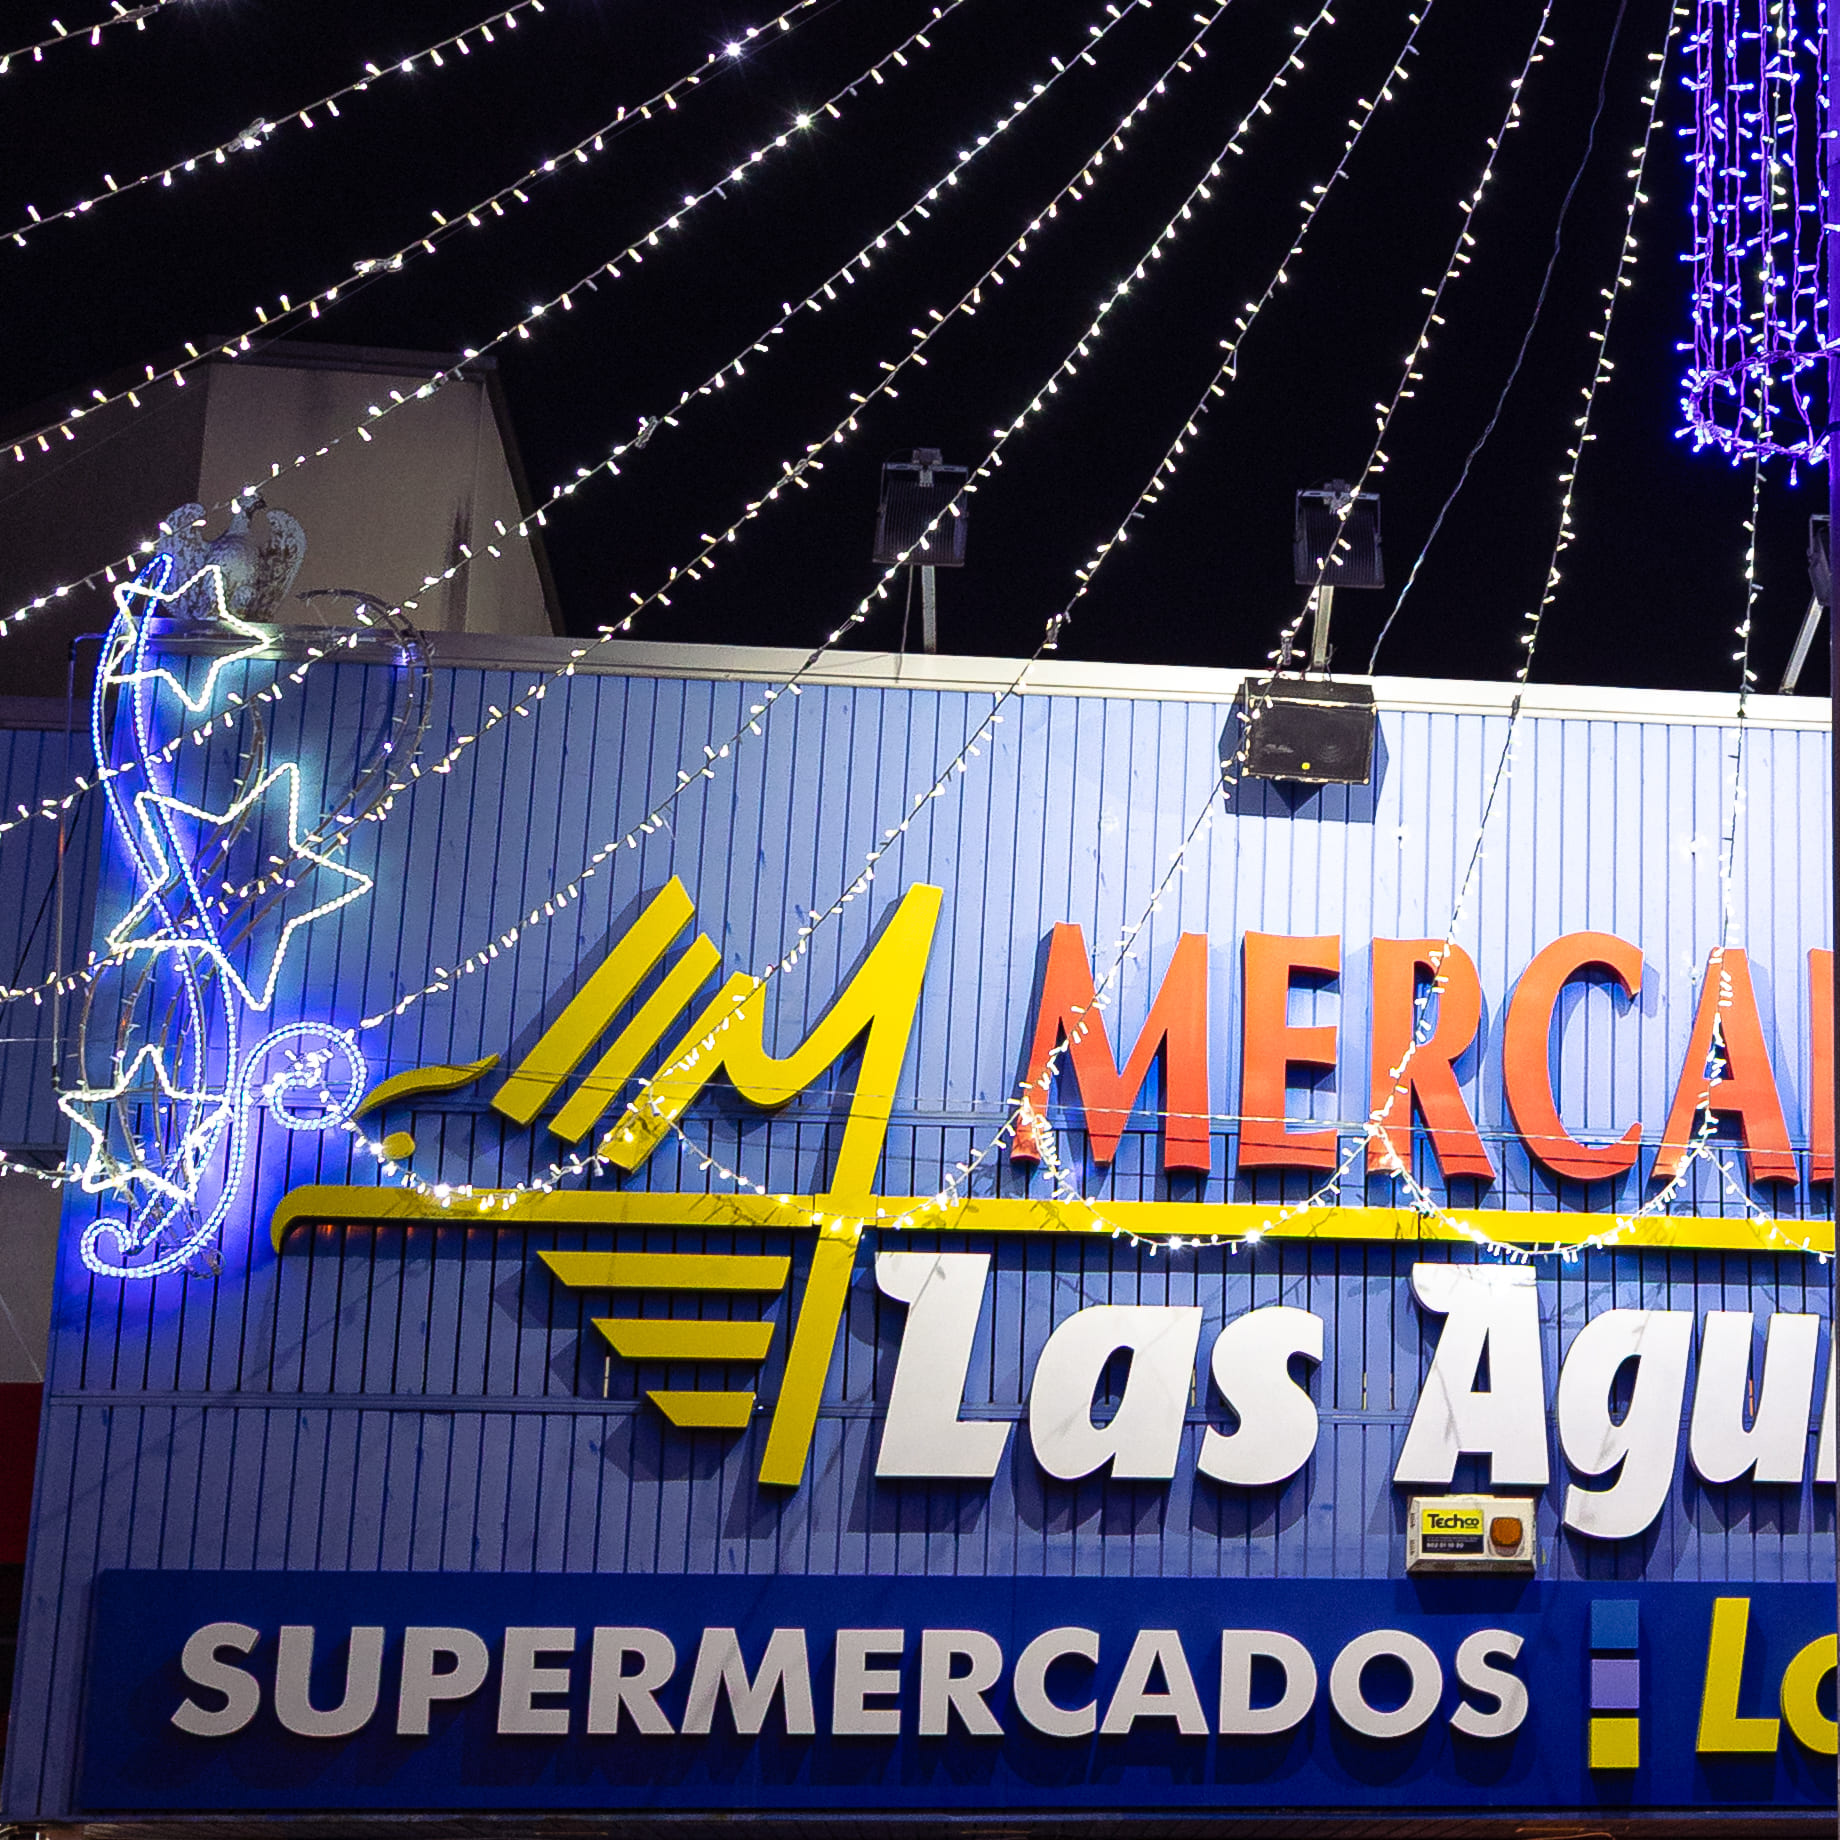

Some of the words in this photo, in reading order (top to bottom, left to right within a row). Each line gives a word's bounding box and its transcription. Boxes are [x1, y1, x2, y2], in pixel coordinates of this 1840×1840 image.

[874, 1252, 1324, 1485] Las
[1427, 1513, 1480, 1529] Techco
[170, 1621, 1529, 1738] SUPERMERCADOS
